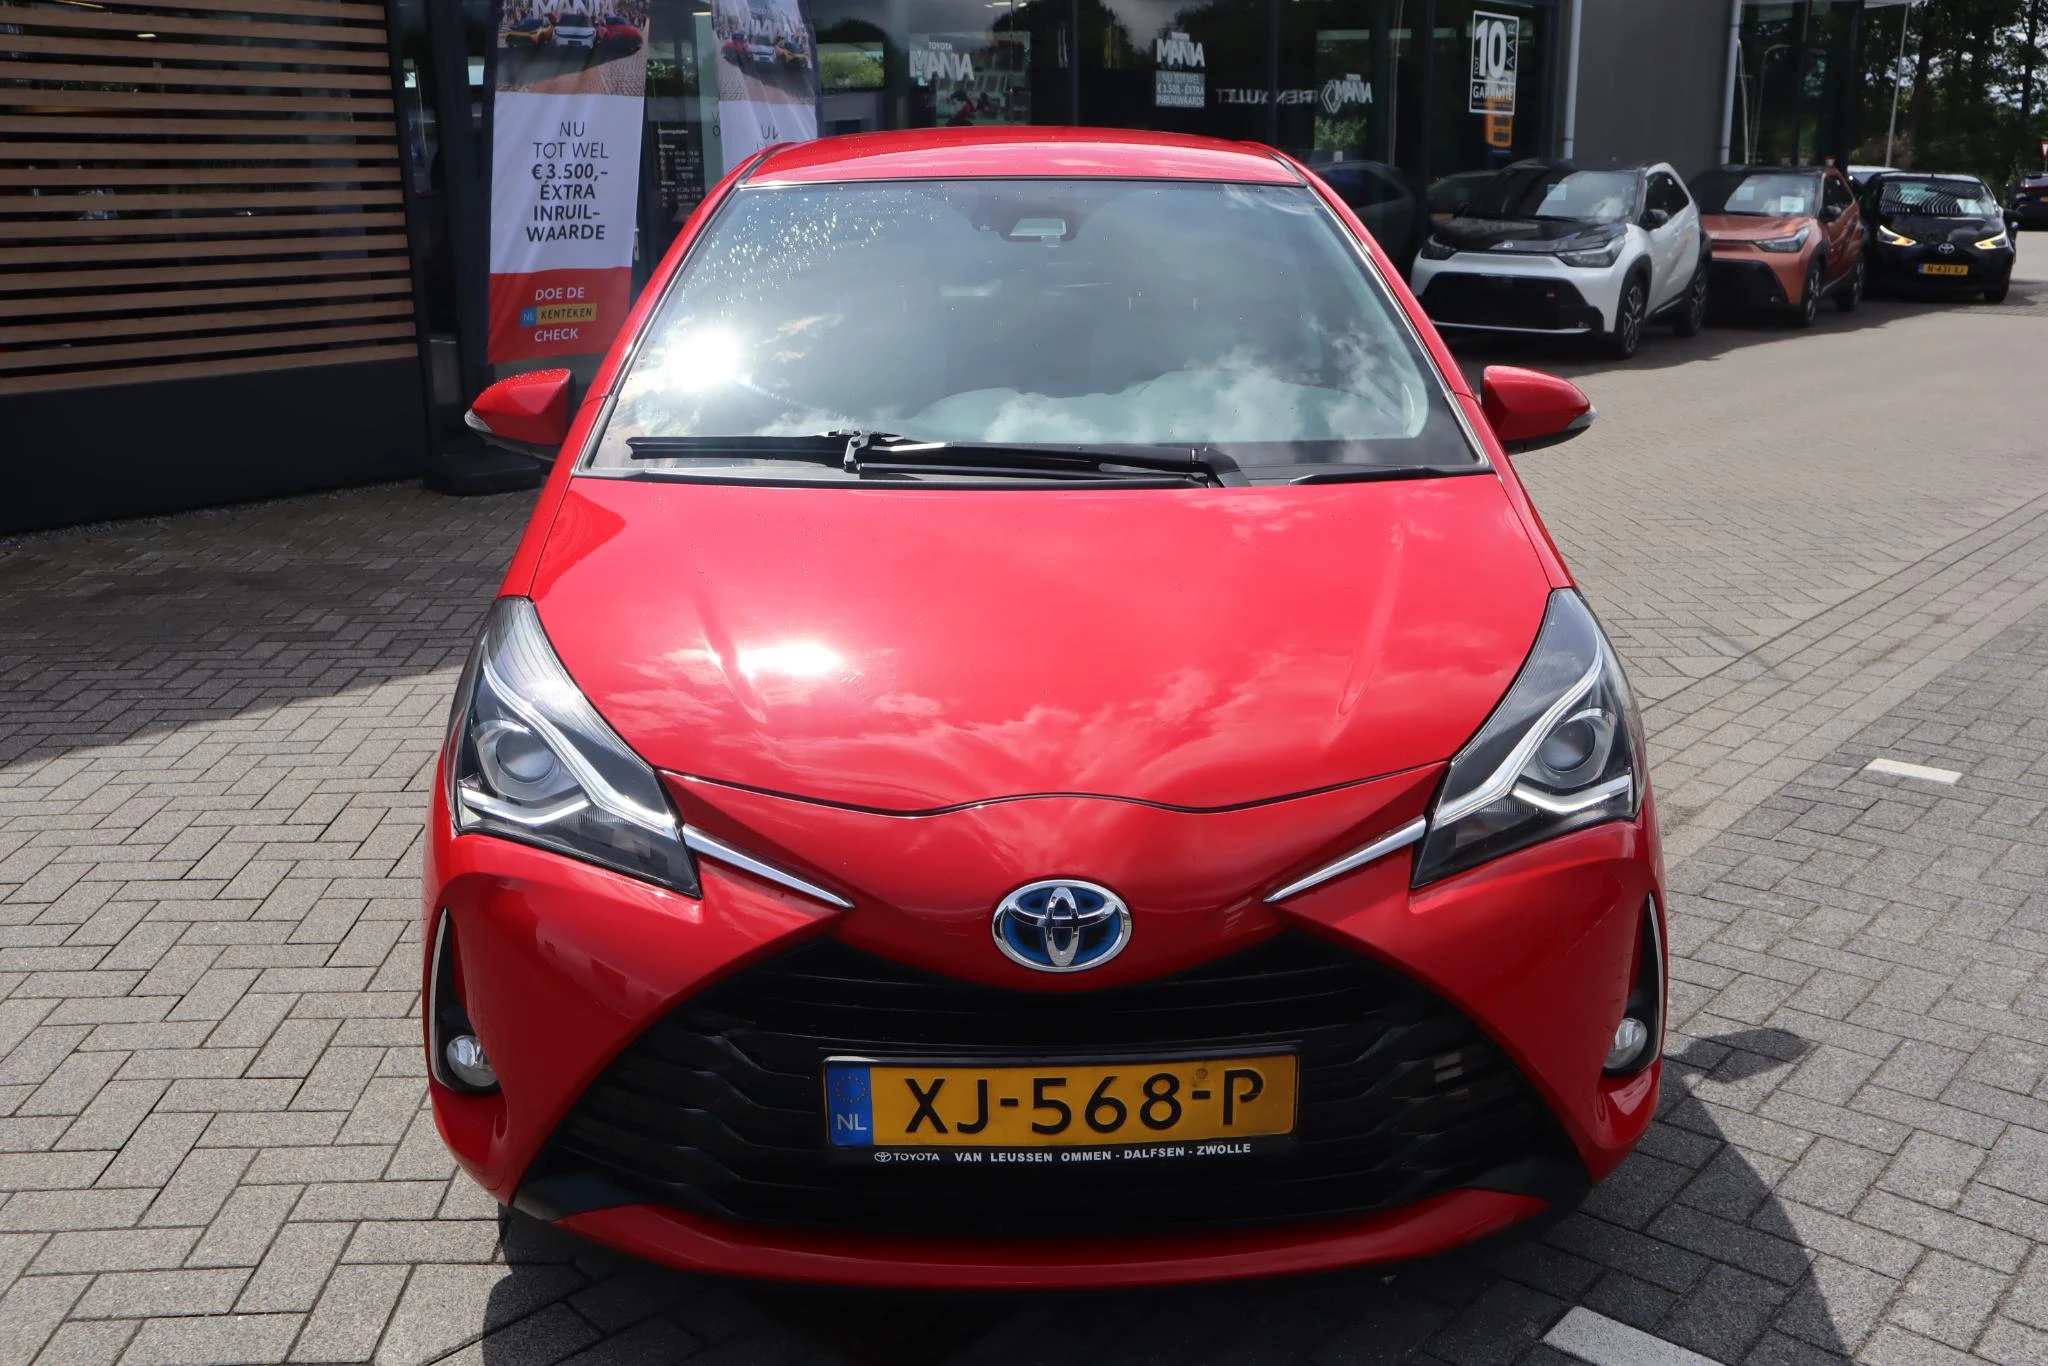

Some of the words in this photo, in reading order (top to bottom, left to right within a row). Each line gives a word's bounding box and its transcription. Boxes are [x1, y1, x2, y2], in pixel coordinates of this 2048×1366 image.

[928, 41, 952, 51] TOYOTA
[1157, 38, 1206, 68] MANIA
[1476, 19, 1506, 79] 10
[909, 50, 975, 81] MANIA
[559, 121, 585, 137] NU
[532, 142, 567, 159] TOT
[572, 142, 609, 159] WEL
[540, 180, 596, 201] ÉXTRA
[534, 204, 601, 222] INRUIL-
[526, 224, 606, 242] WAARDE
[535, 287, 563, 301] DOE
[566, 286, 585, 299] DE
[540, 307, 593, 320] KENTEKEN
[534, 327, 579, 342] CHECK
[904, 1068, 1264, 1136] XJ-568-P
[836, 1112, 868, 1132] NL
[893, 1152, 940, 1161] TOYOTA
[954, 1152, 982, 1162] VAN
[990, 1152, 1053, 1162] LEUSSEN
[1060, 1151, 1112, 1162] OMMEN
[1124, 1147, 1184, 1160] DALFSEN
[1196, 1143, 1251, 1156] ZWOLLE
